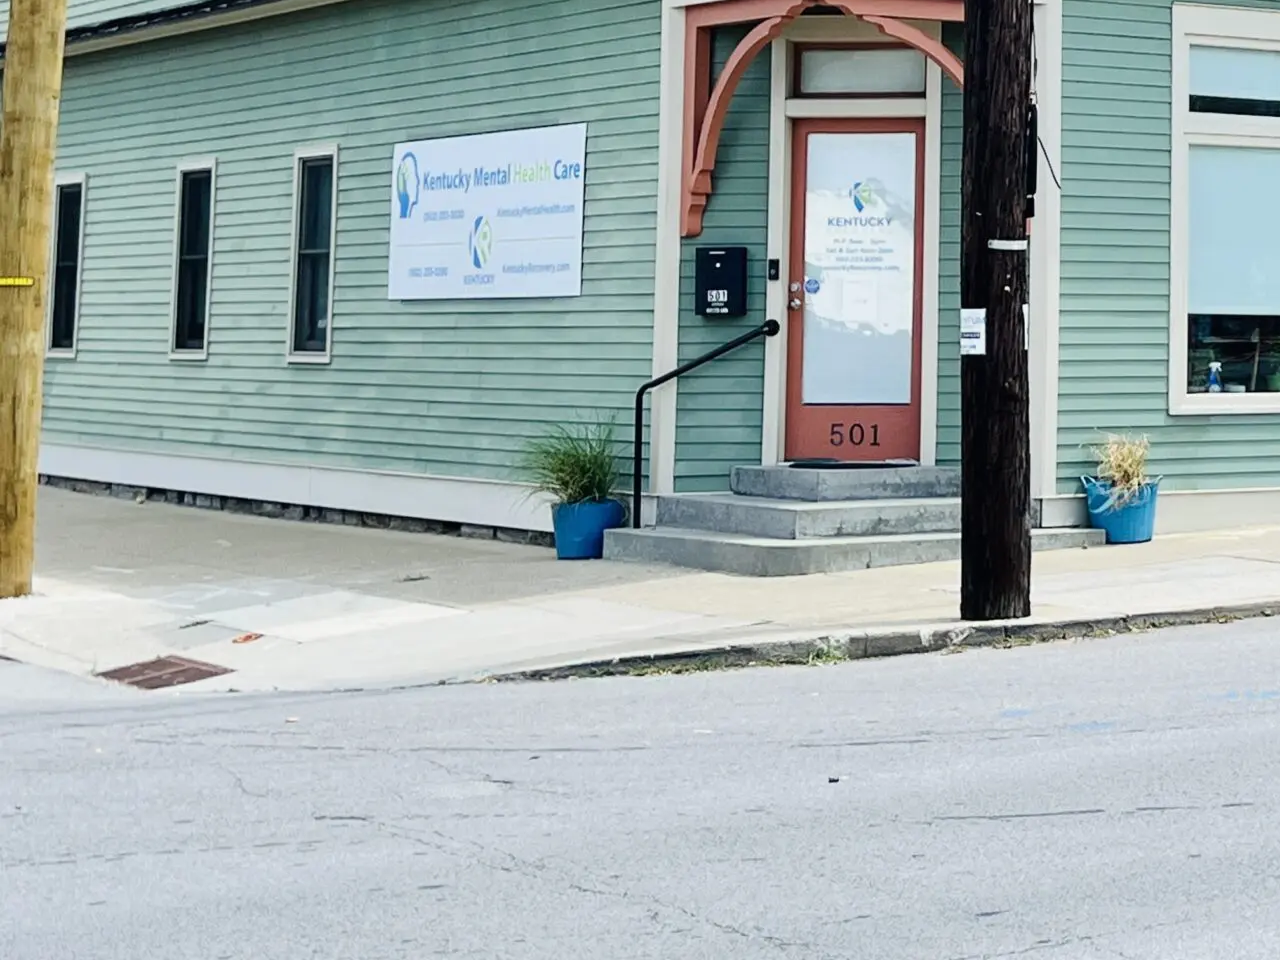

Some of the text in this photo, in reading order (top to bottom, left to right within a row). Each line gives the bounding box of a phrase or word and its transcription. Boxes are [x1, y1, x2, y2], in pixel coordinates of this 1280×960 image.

[423, 159, 581, 194] Kentucky Mental Health Care
[827, 216, 892, 227] KENTUCKY
[708, 290, 726, 302] 501
[830, 423, 881, 446] 501
